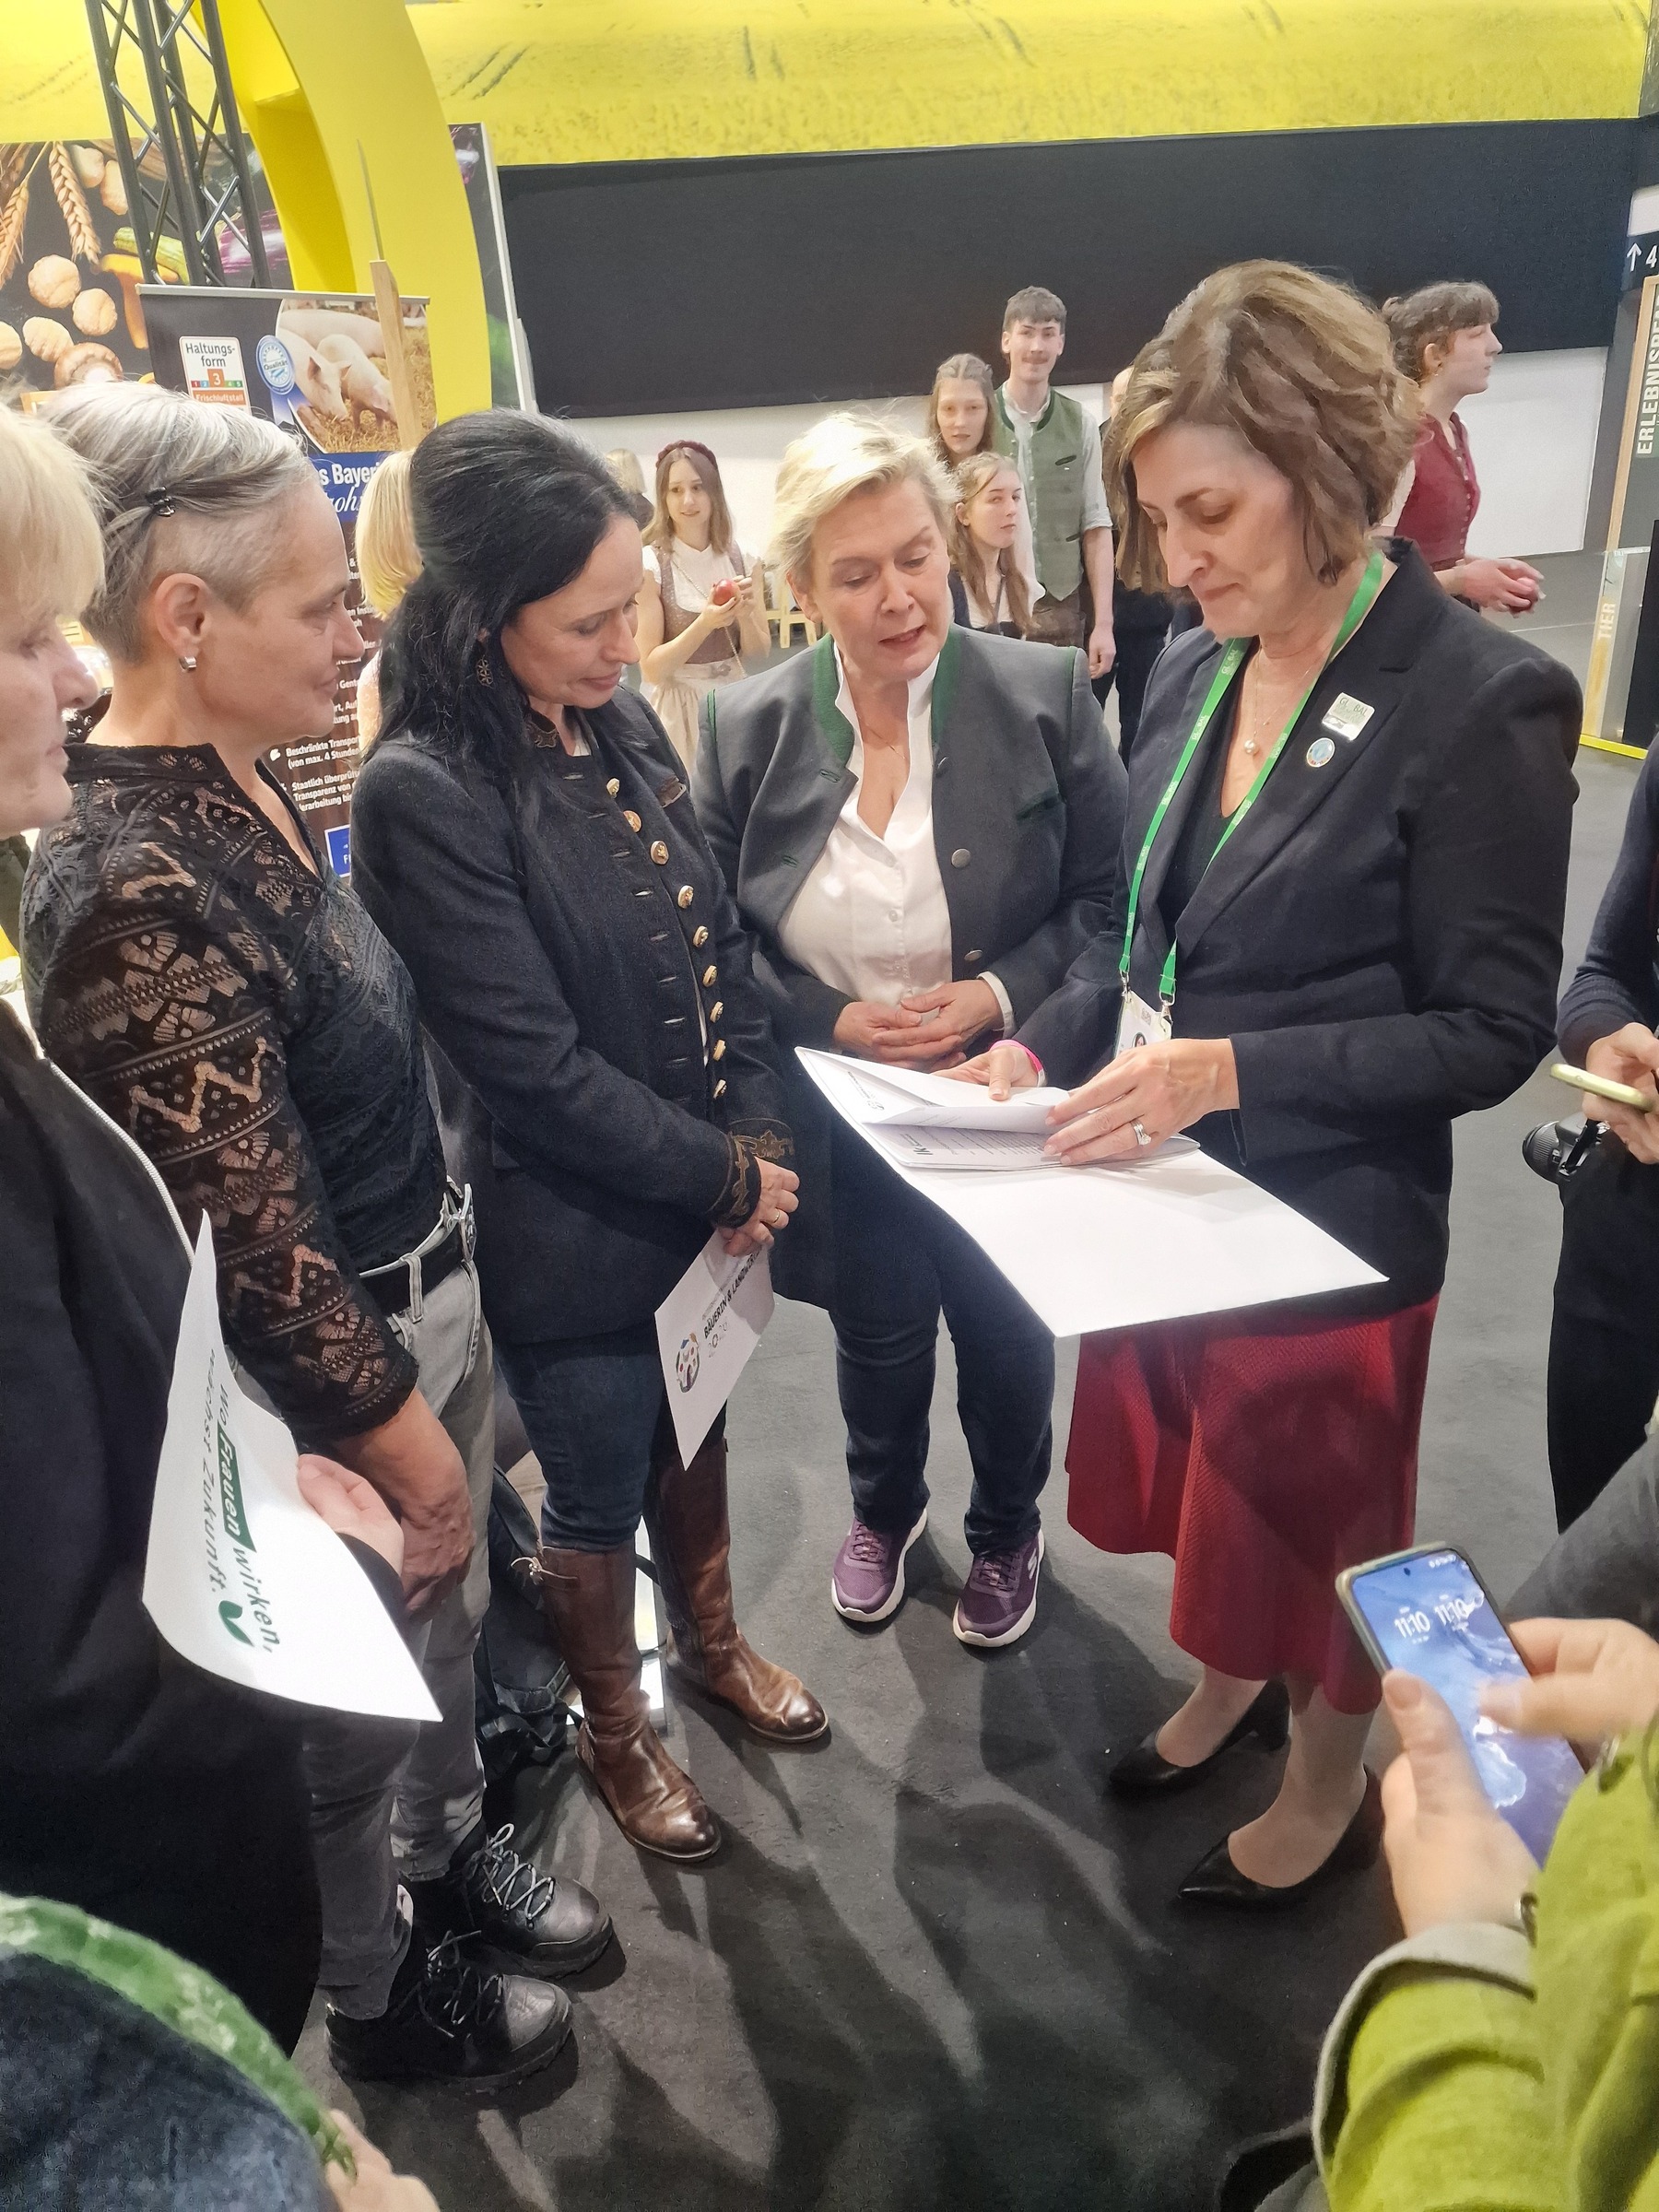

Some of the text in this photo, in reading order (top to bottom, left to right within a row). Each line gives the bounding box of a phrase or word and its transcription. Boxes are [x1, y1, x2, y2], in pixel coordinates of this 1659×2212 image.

[185, 342, 236, 357] Haltungs-
[200, 355, 227, 368] form
[212, 372, 221, 386] 3
[194, 393, 244, 403] Frischluftstall
[1597, 603, 1616, 641] TIER
[286, 741, 329, 758] Beschränkte
[288, 759, 305, 771] (von
[305, 755, 324, 765] max.
[324, 751, 331, 760] 4
[291, 777, 324, 792] Staatlich
[292, 783, 351, 801] Transparenz von
[703, 1295, 727, 1340] BÄUERIN
[203, 1458, 227, 1593] Zukunft.
[219, 1383, 280, 1653] Wo Frauen wirken,
